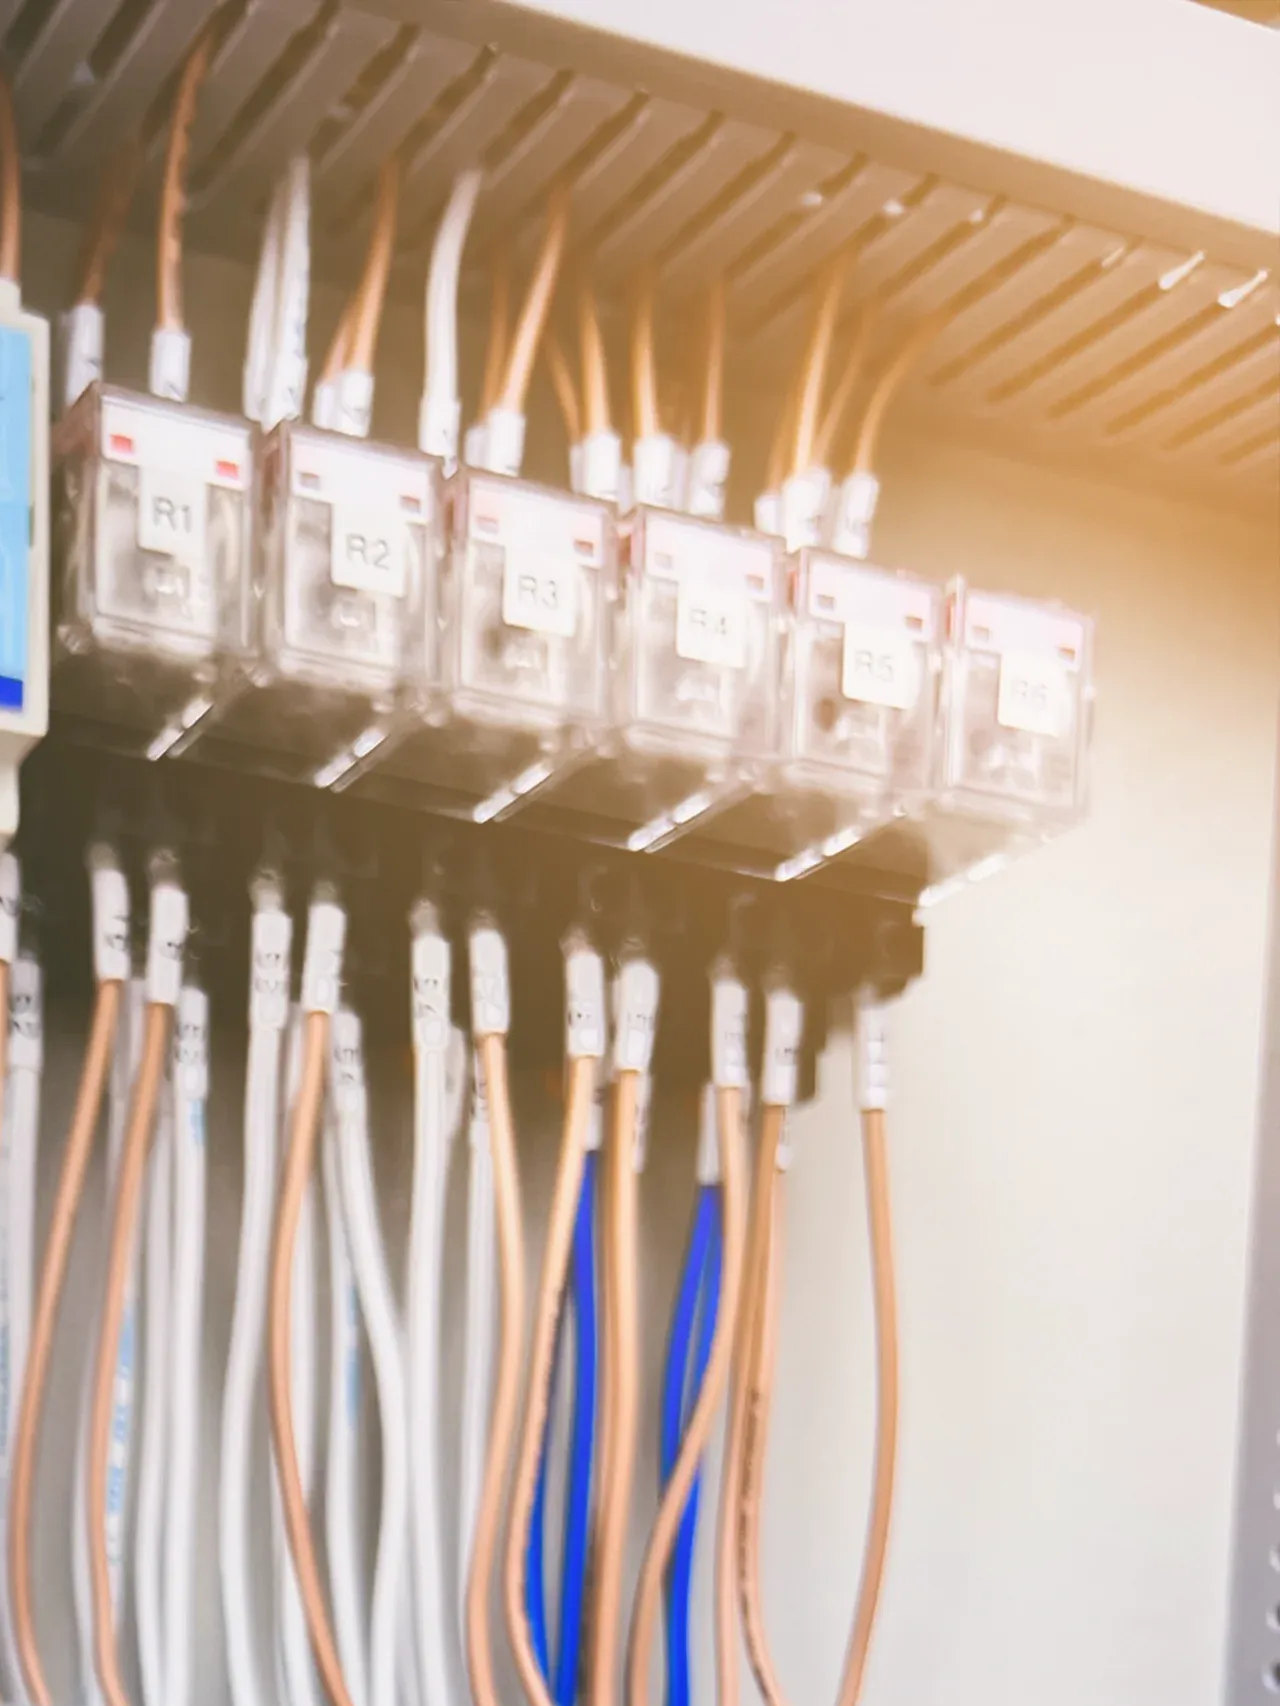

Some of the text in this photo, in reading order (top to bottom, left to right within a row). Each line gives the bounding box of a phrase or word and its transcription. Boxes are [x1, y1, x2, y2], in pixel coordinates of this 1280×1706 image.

[152, 498, 192, 533] R1
[345, 534, 391, 570] R2
[518, 577, 559, 611] R3
